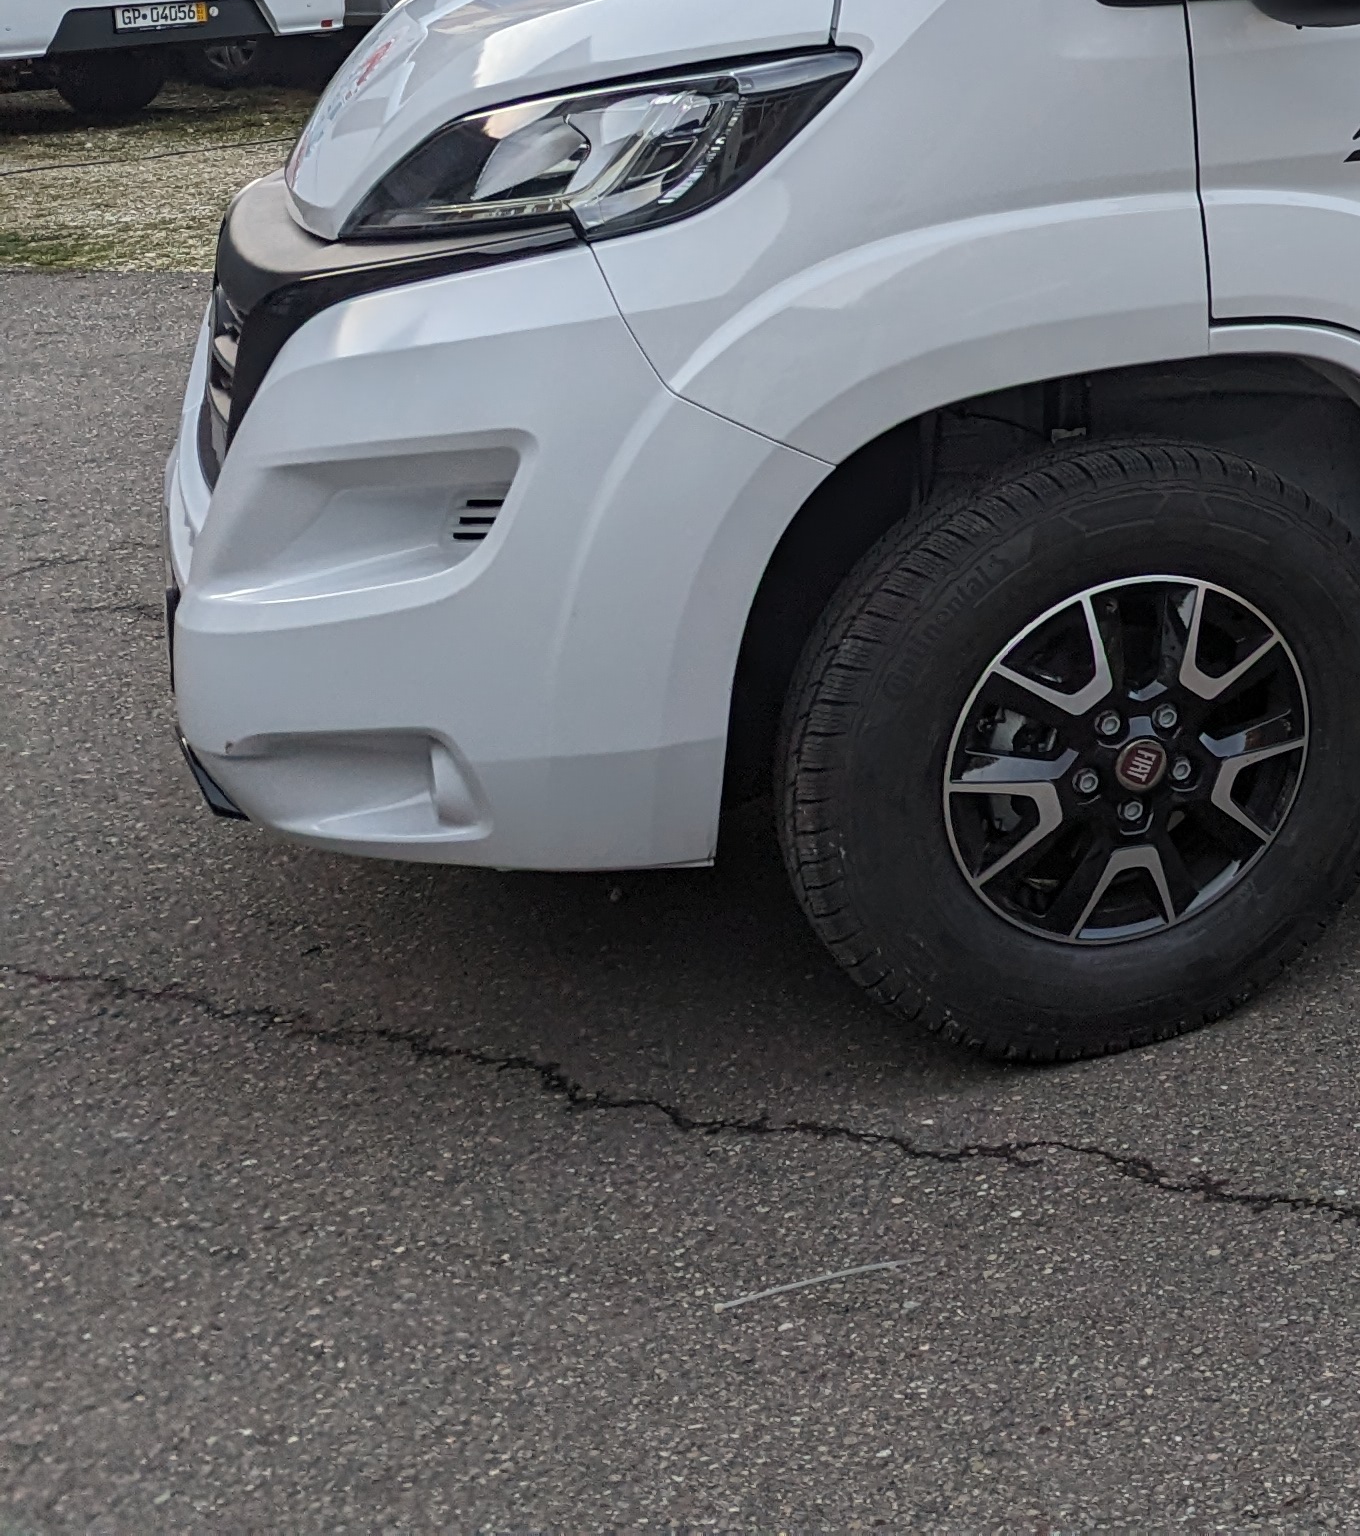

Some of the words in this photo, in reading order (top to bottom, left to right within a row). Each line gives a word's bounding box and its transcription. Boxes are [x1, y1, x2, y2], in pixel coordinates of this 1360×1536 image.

[121, 8, 141, 25] GP
[150, 4, 196, 22] 04056
[1126, 749, 1157, 782] FIAT
